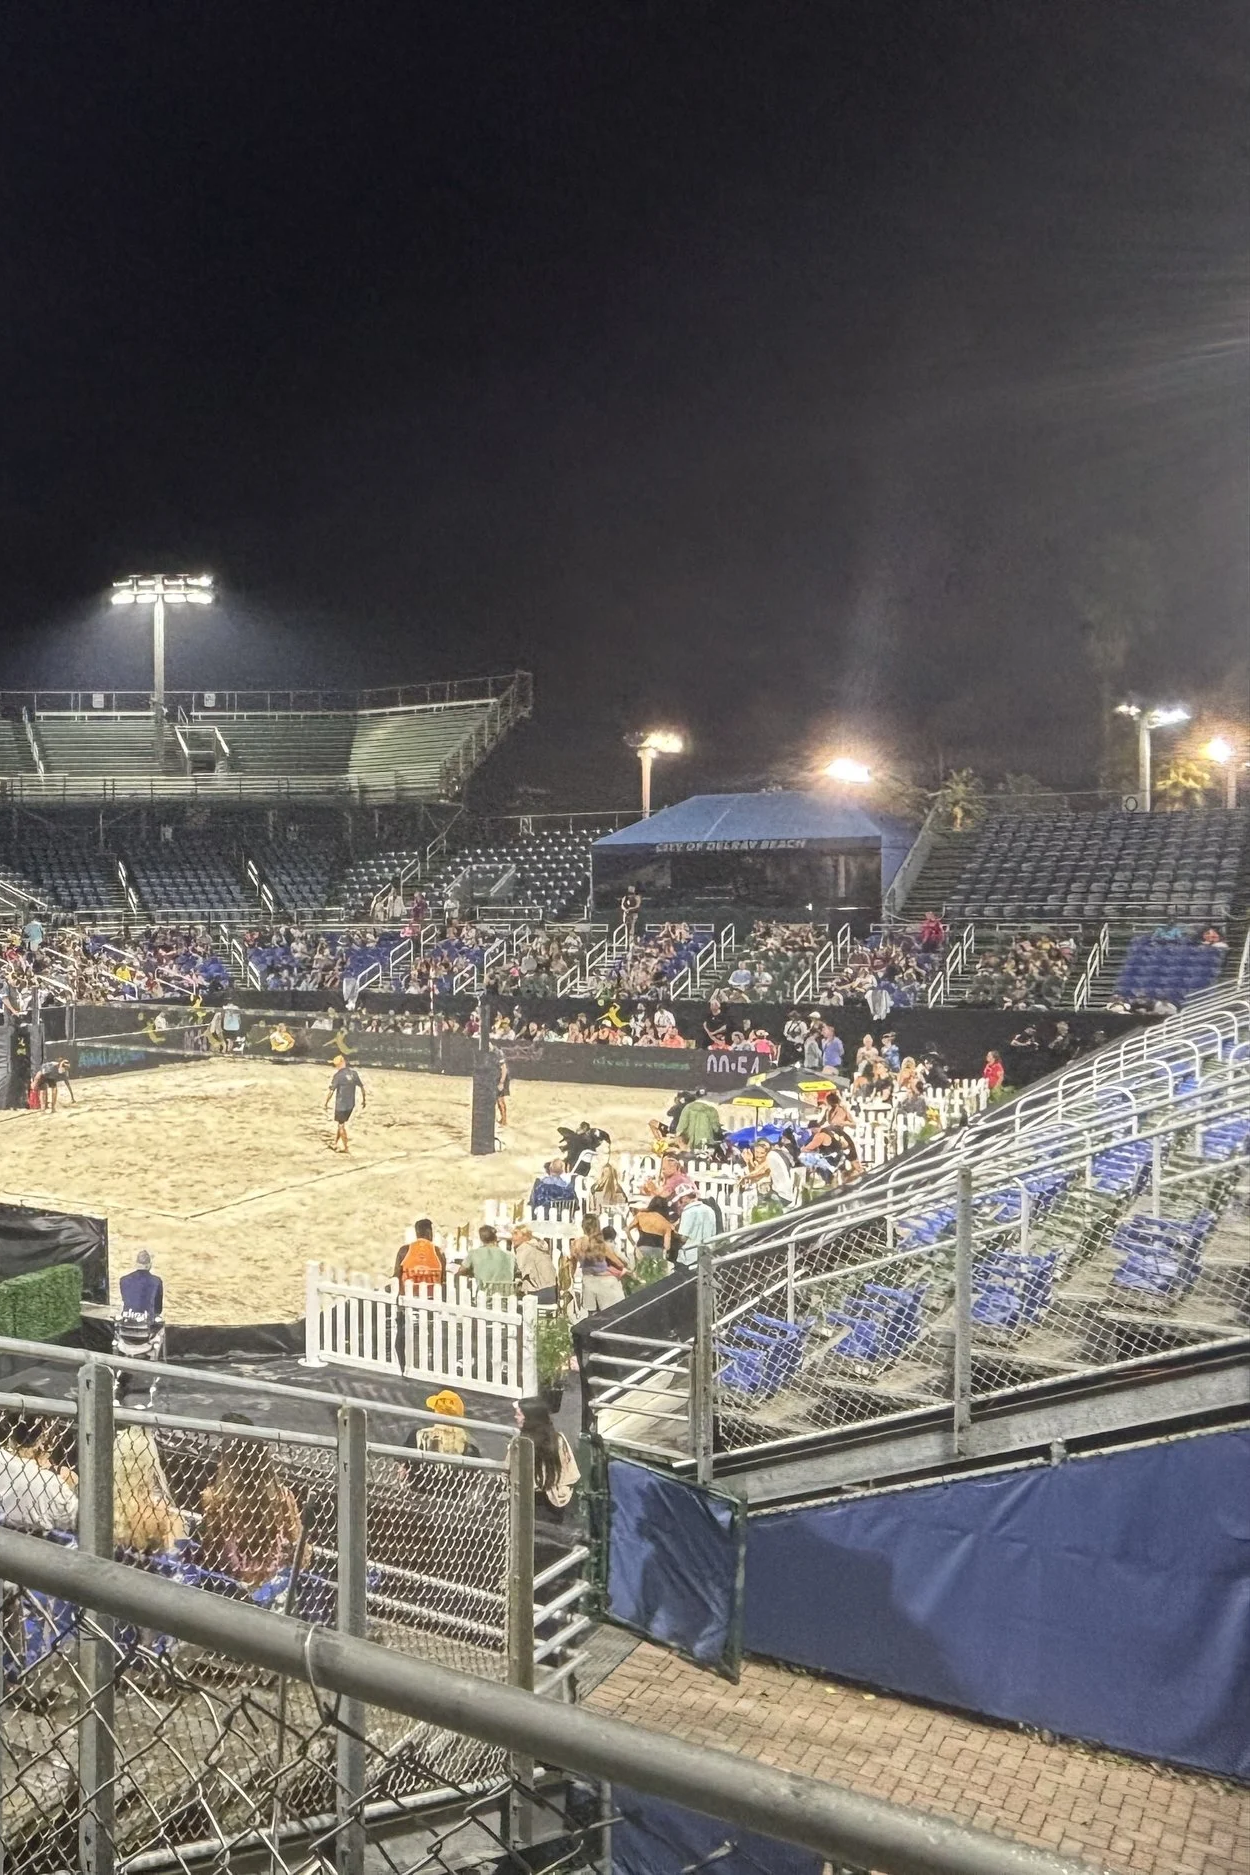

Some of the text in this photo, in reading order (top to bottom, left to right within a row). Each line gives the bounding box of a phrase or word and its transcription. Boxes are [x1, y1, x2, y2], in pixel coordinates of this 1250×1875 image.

[655, 838, 806, 853] CITY OF DELRAY BEACH
